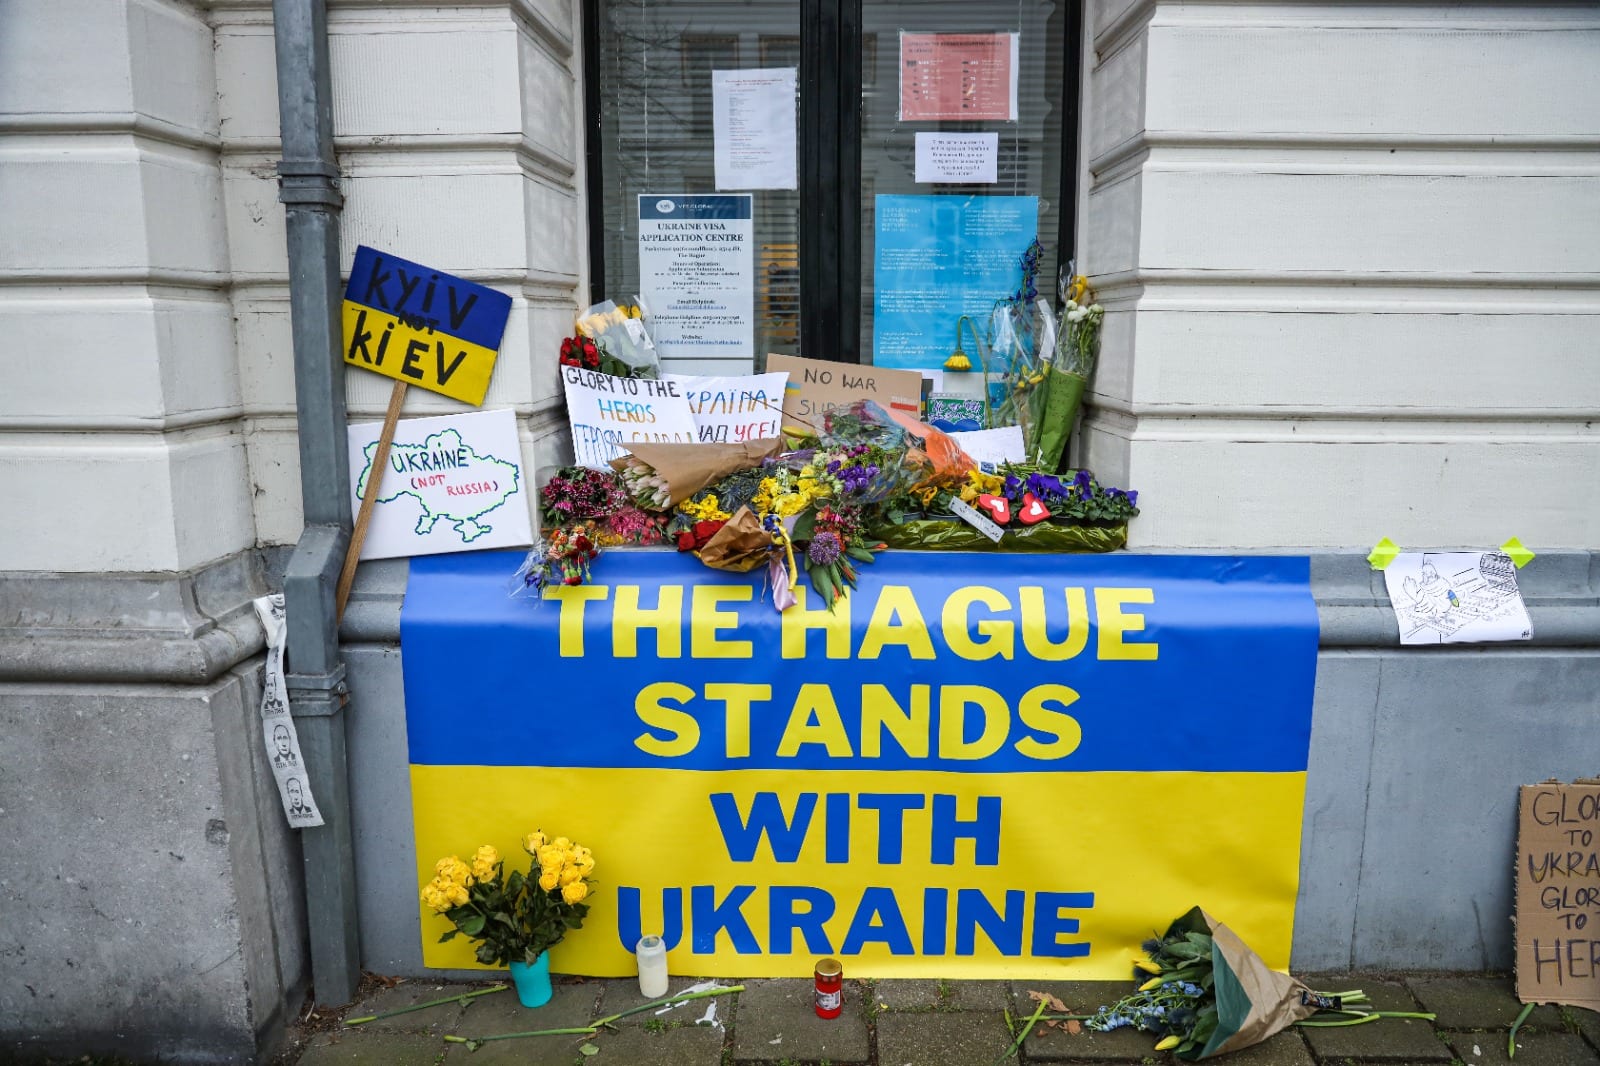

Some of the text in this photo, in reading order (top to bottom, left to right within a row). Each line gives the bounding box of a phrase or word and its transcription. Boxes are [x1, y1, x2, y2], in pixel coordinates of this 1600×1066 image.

[640, 233, 744, 242] APPLICATION CENTRE
[398, 311, 440, 335] NOT
[566, 367, 681, 398] GLORY TO THE
[804, 367, 877, 393] NO WAR
[597, 398, 656, 424] HEROS
[411, 475, 446, 490] (NOT
[447, 481, 498, 496] RUSSIA)
[543, 585, 1159, 661] THE HAGUE
[634, 682, 1082, 760] STANDS
[1532, 791, 1600, 826] GLO
[709, 792, 1001, 866] WITH
[1563, 829, 1592, 847] TO
[617, 885, 1095, 957] UKRAINE
[1557, 913, 1588, 931] TO
